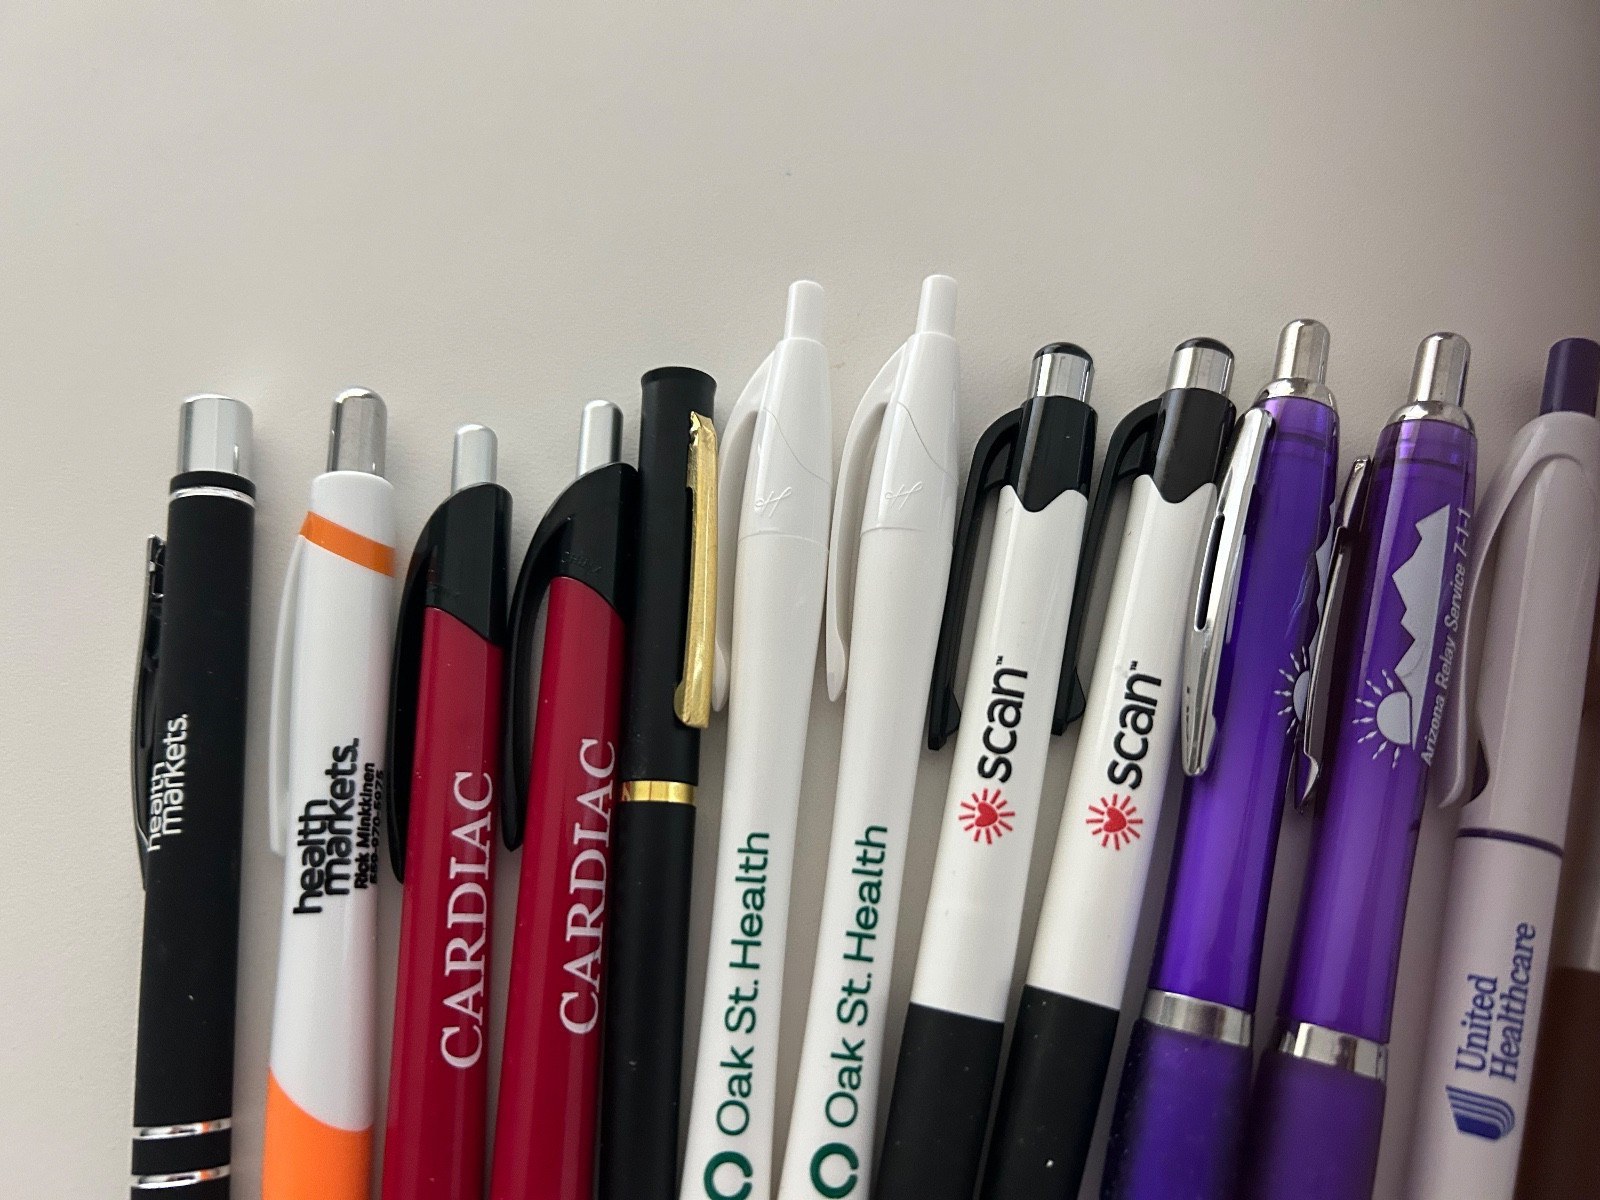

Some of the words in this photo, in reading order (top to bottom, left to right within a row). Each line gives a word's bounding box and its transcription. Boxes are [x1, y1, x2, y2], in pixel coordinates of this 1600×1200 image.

[1452, 506, 1472, 559] 7-1-1
[1443, 562, 1467, 632] Service
[1435, 634, 1457, 690] Relay
[1421, 695, 1446, 767] Arizona
[147, 761, 165, 853] health
[356, 762, 376, 848] Minkkinen
[293, 799, 328, 915] health
[353, 853, 370, 890] Rick
[559, 738, 616, 1034] CARDIAC
[729, 831, 770, 971] Health
[843, 824, 888, 964] Health
[440, 770, 493, 1069] CARDIAC
[725, 978, 760, 1035] St.
[837, 971, 872, 1027] St.
[1454, 973, 1498, 1072] United
[1488, 921, 1536, 1083] Healthcare
[716, 1045, 755, 1137] Oak
[825, 1038, 866, 1129] Oak
